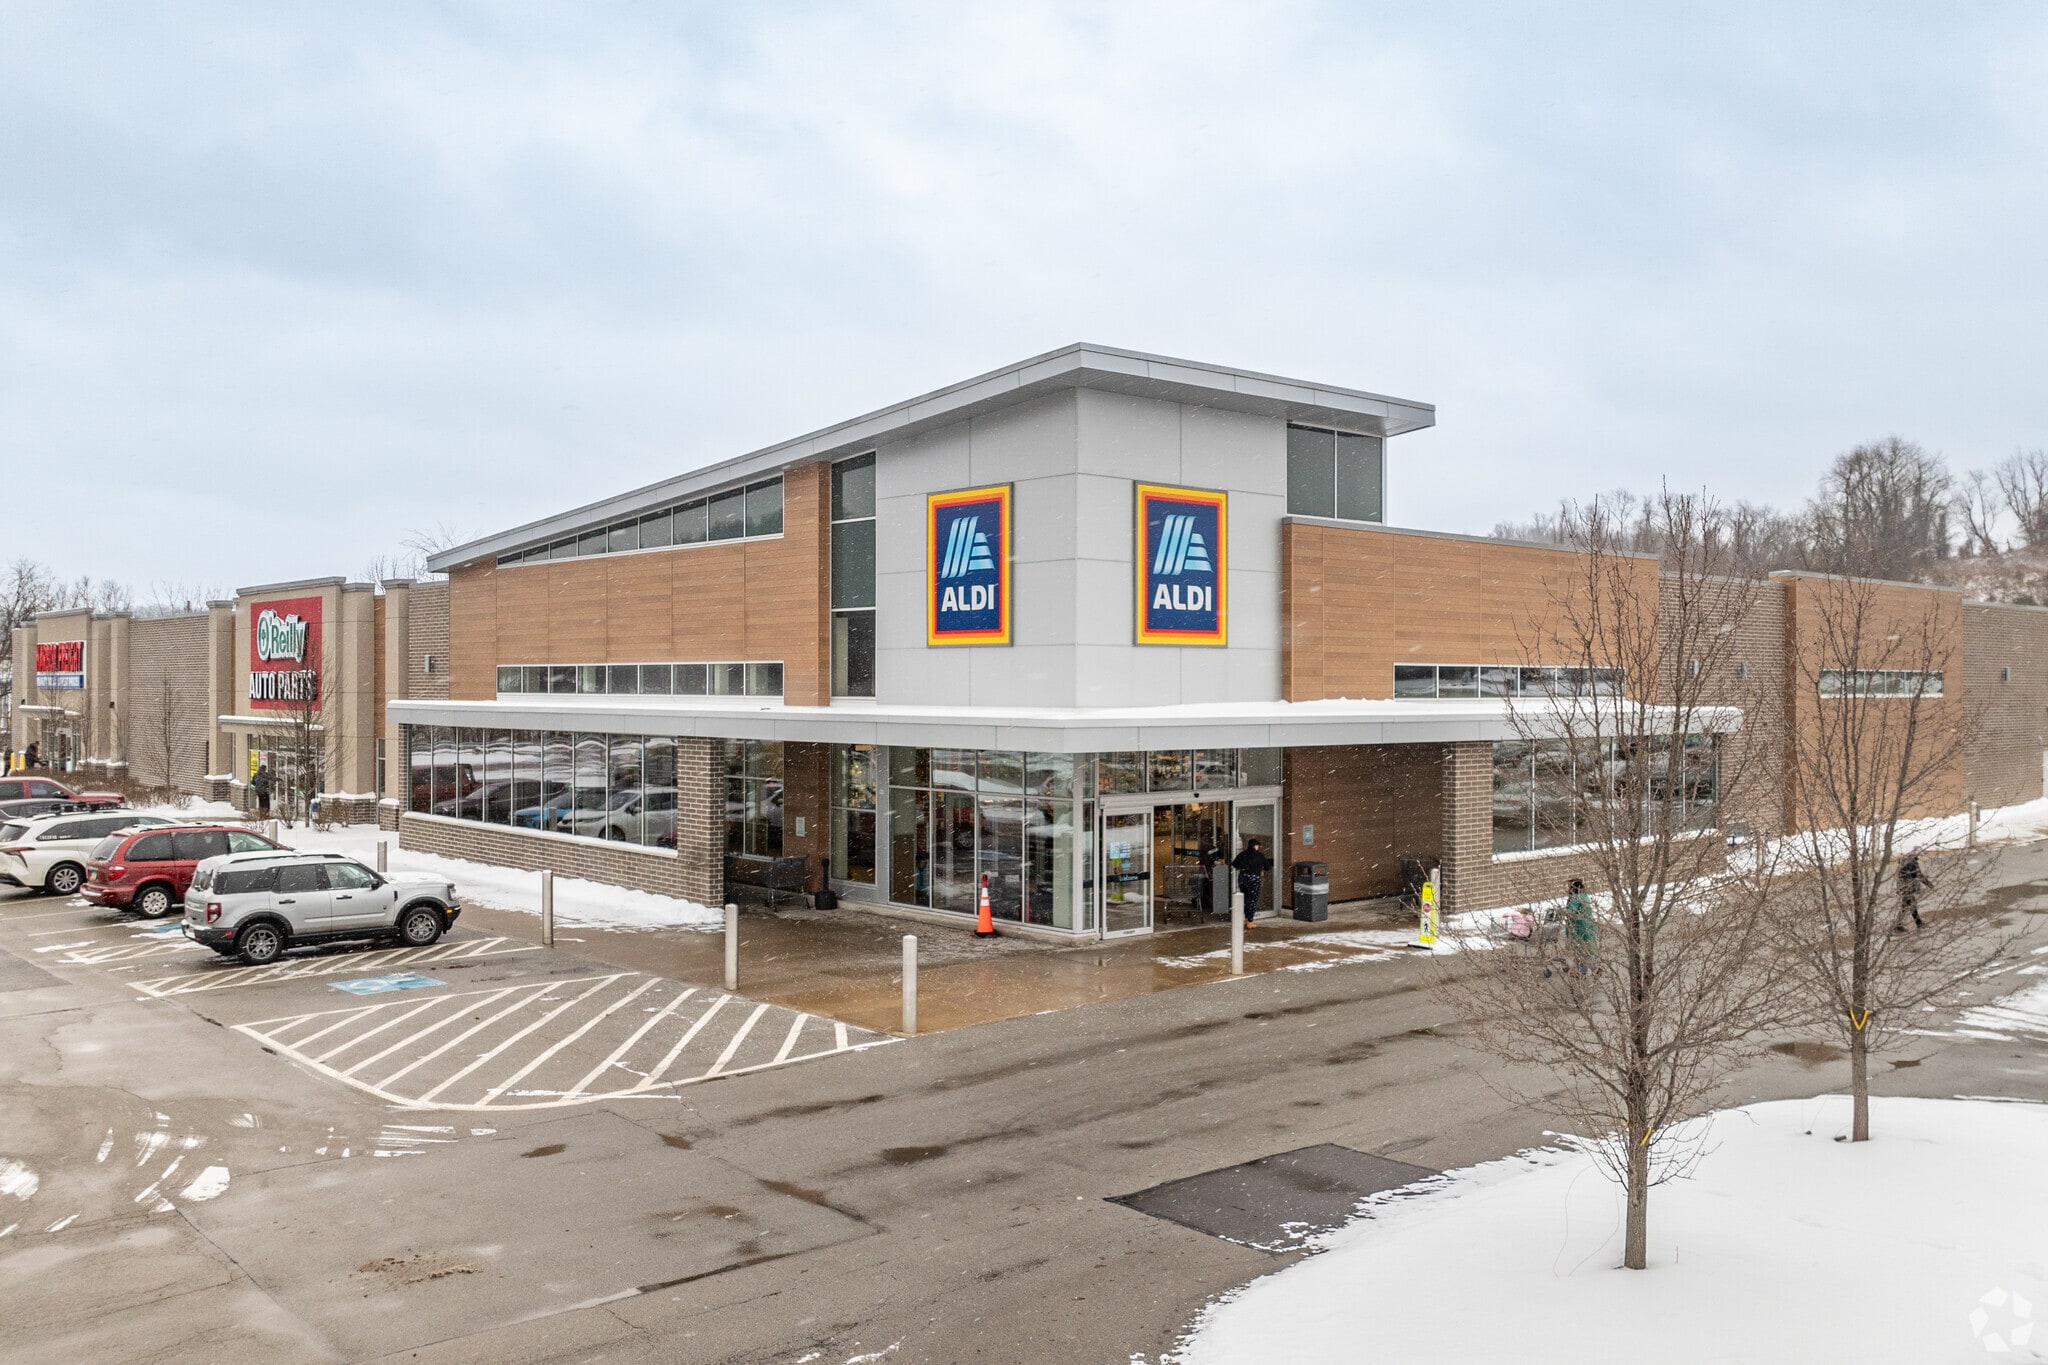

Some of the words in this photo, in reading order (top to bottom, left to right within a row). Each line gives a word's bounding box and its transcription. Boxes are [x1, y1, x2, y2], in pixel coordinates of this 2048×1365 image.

[941, 584, 994, 612] ALDI
[1153, 583, 1212, 611] ALDI
[257, 610, 306, 663] O'Reilly
[249, 672, 275, 699] AUTO
